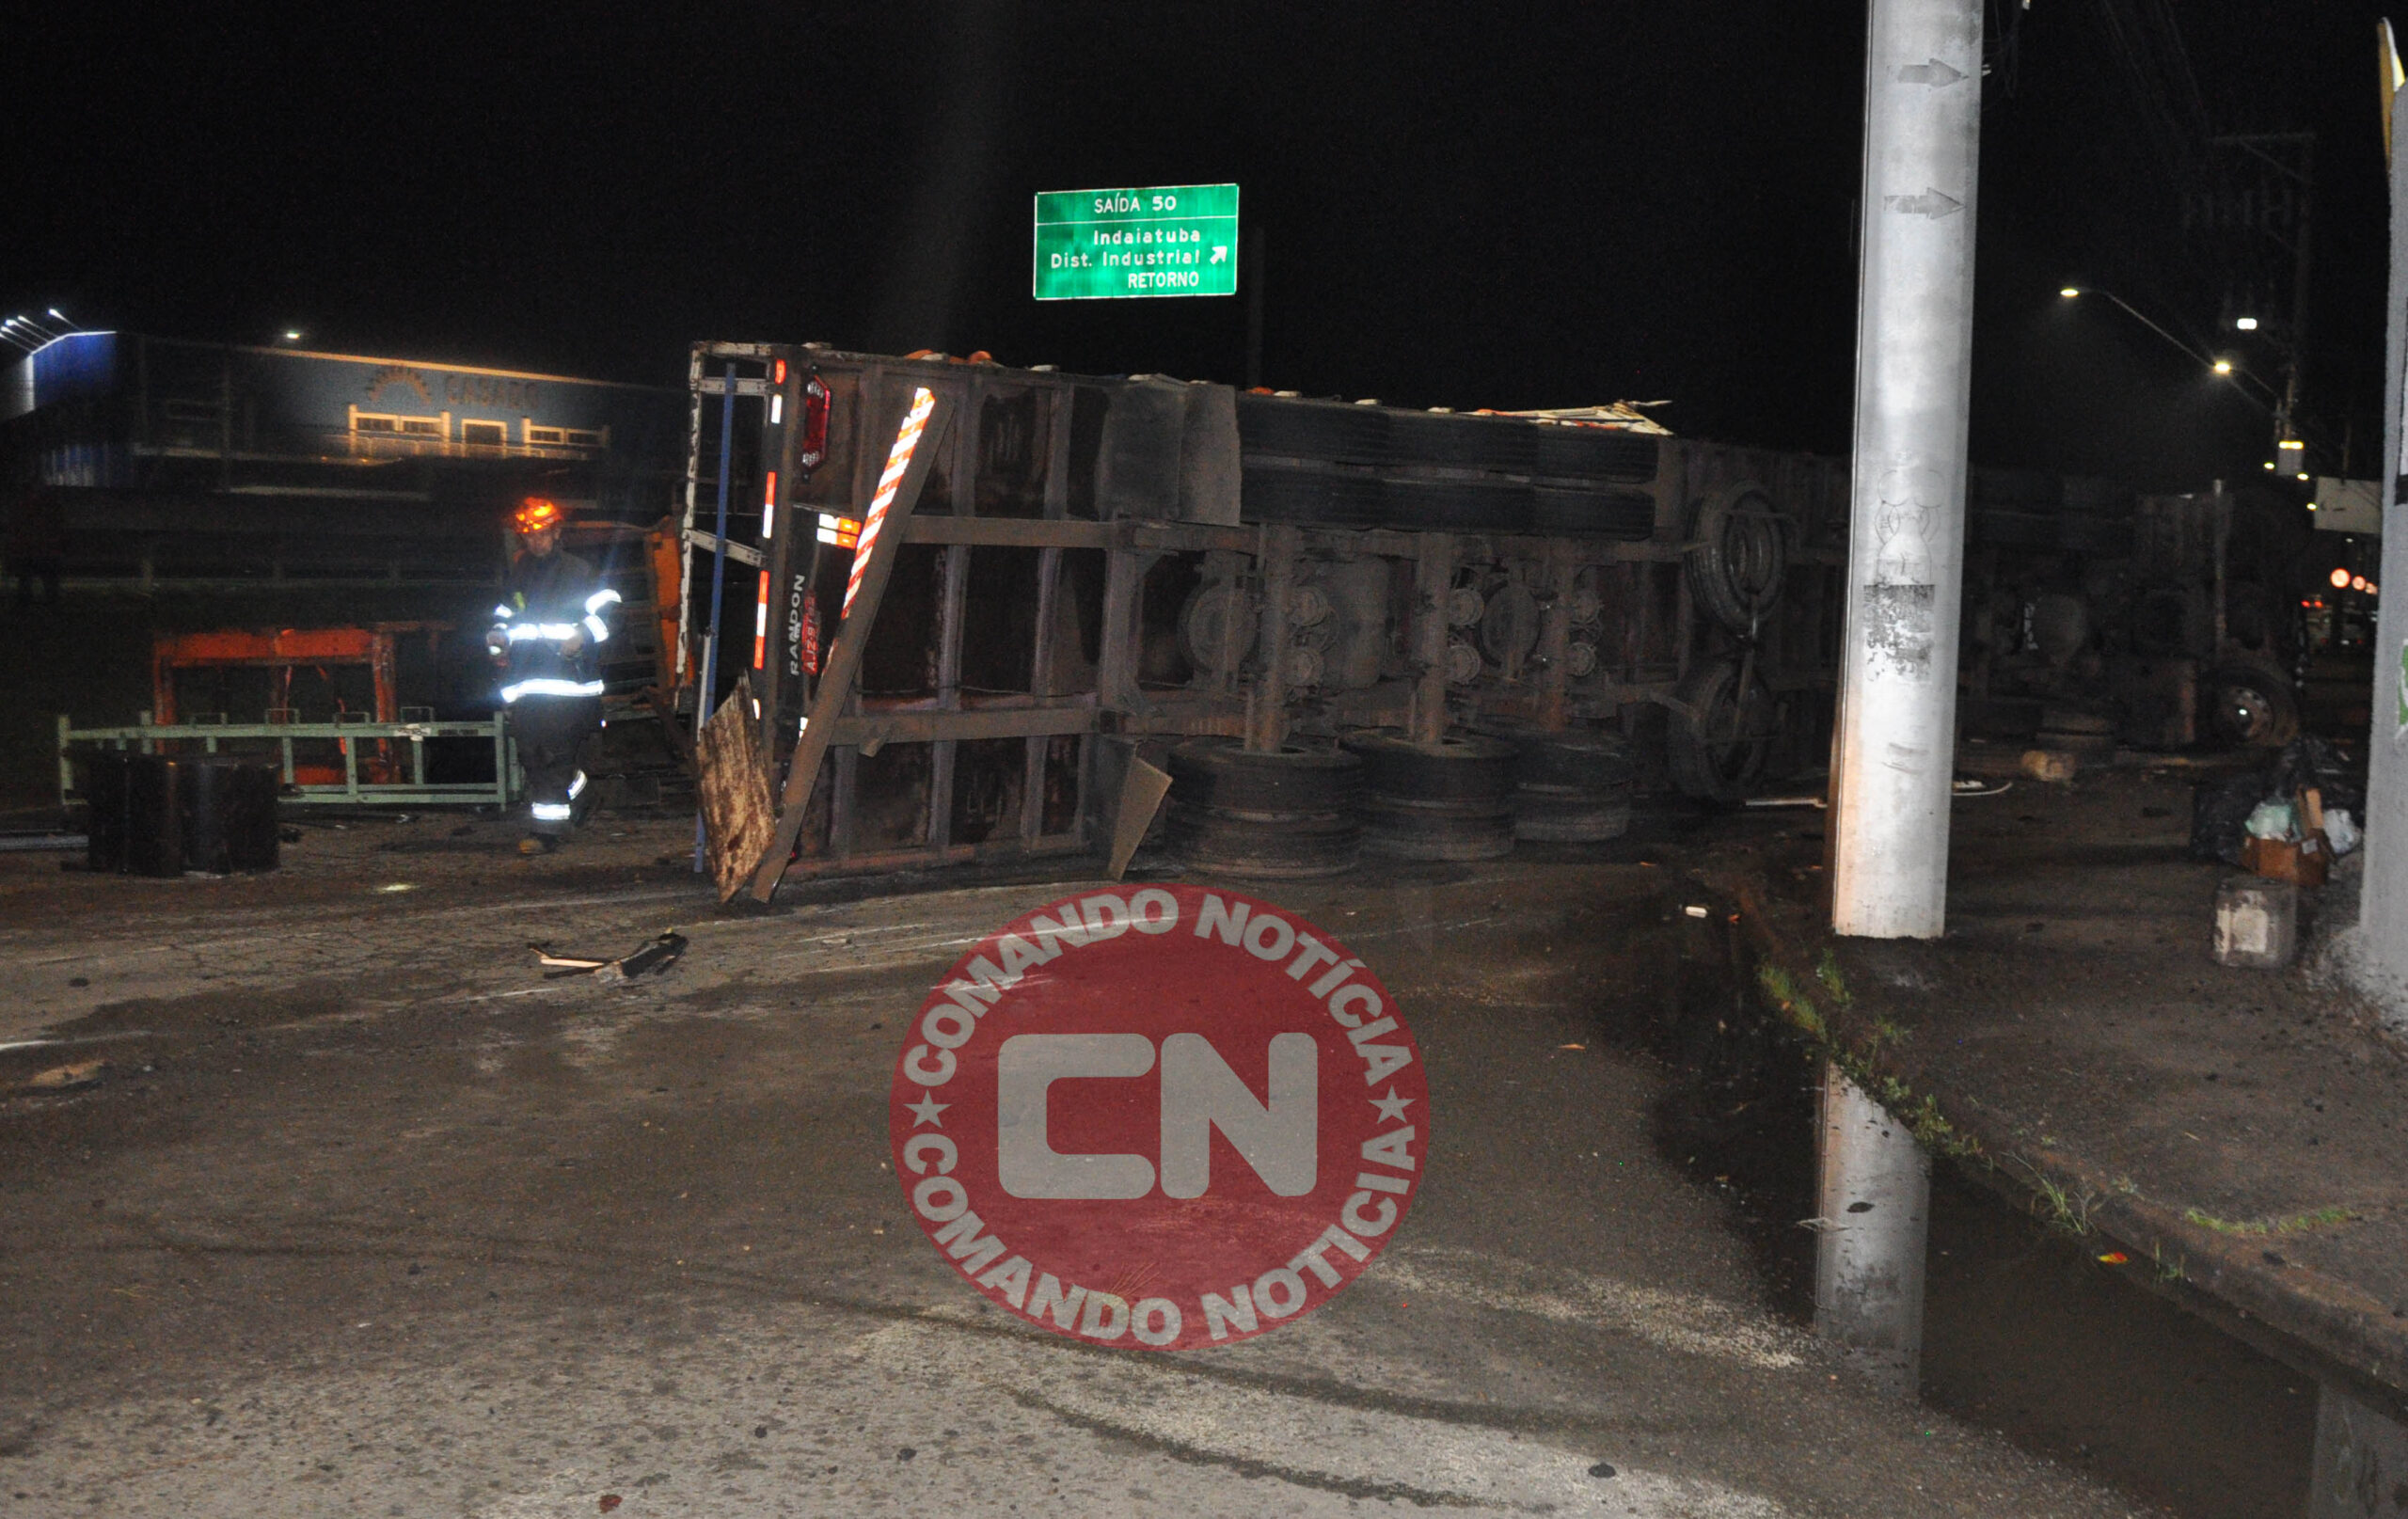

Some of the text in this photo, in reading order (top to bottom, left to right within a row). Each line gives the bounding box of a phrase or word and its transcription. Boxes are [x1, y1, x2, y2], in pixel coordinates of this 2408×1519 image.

[1094, 192, 1177, 214] SAÍDA 50
[1094, 228, 1200, 245] Indaiatuba
[1051, 249, 1200, 269] Dist. Industrial
[1128, 271, 1199, 289] RETORNO
[789, 574, 806, 676] RANDON
